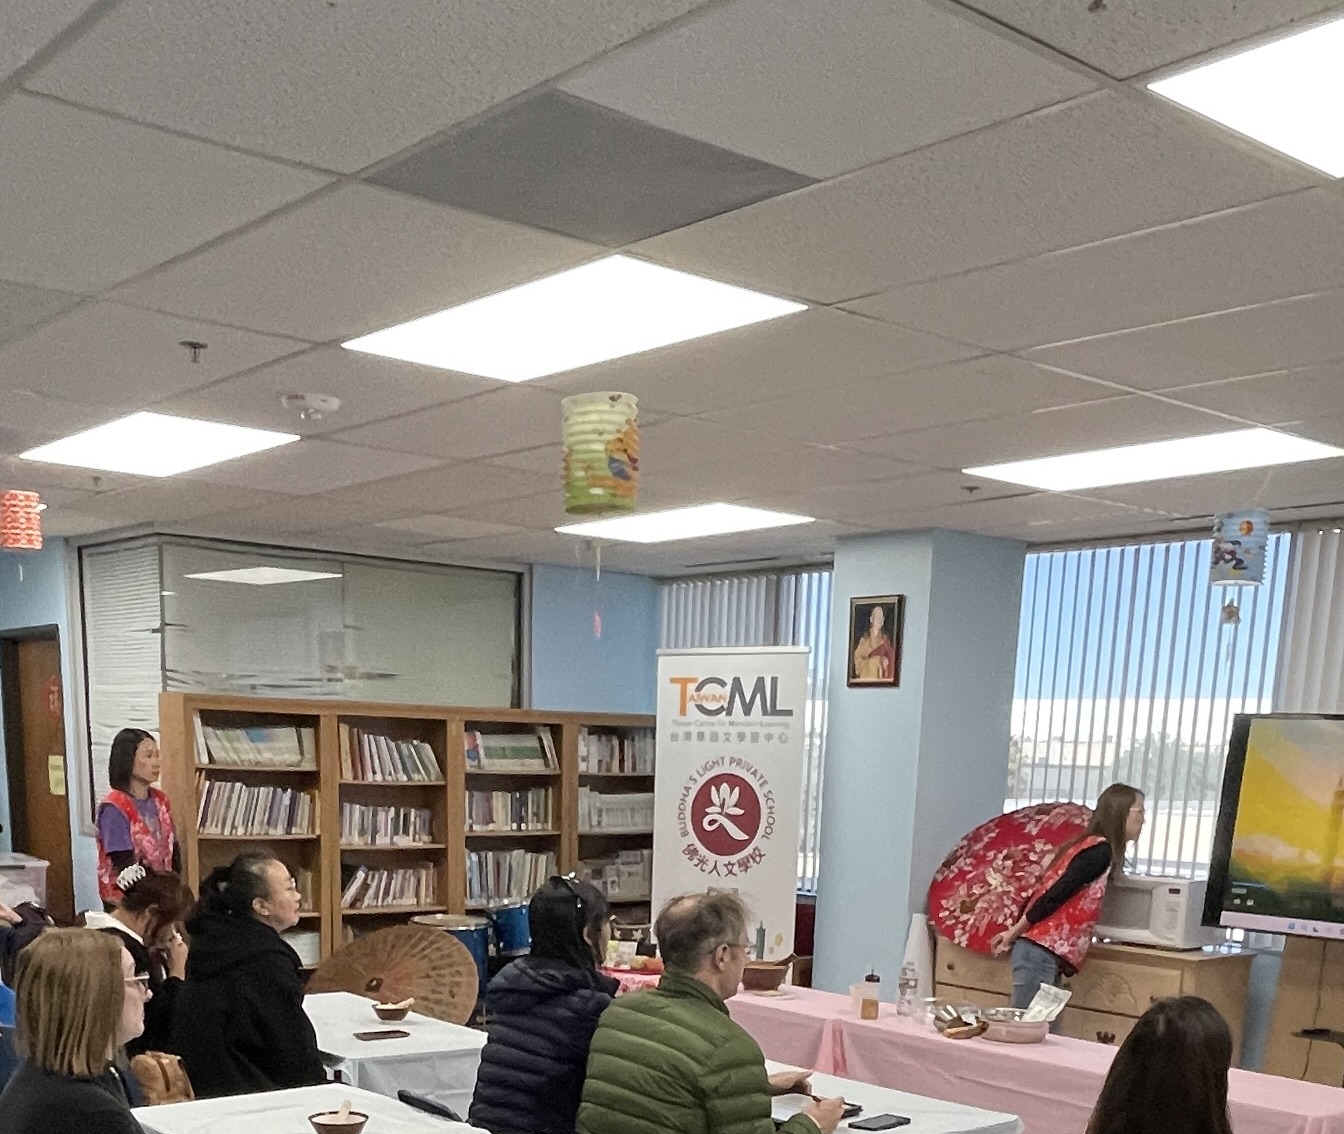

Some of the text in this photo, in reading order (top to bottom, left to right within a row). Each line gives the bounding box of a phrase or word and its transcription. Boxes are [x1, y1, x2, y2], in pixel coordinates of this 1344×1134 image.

[670, 676, 794, 717] TCML
[677, 756, 776, 840] BUDDHA'S LIGHT PRIVATE SCHOOL
